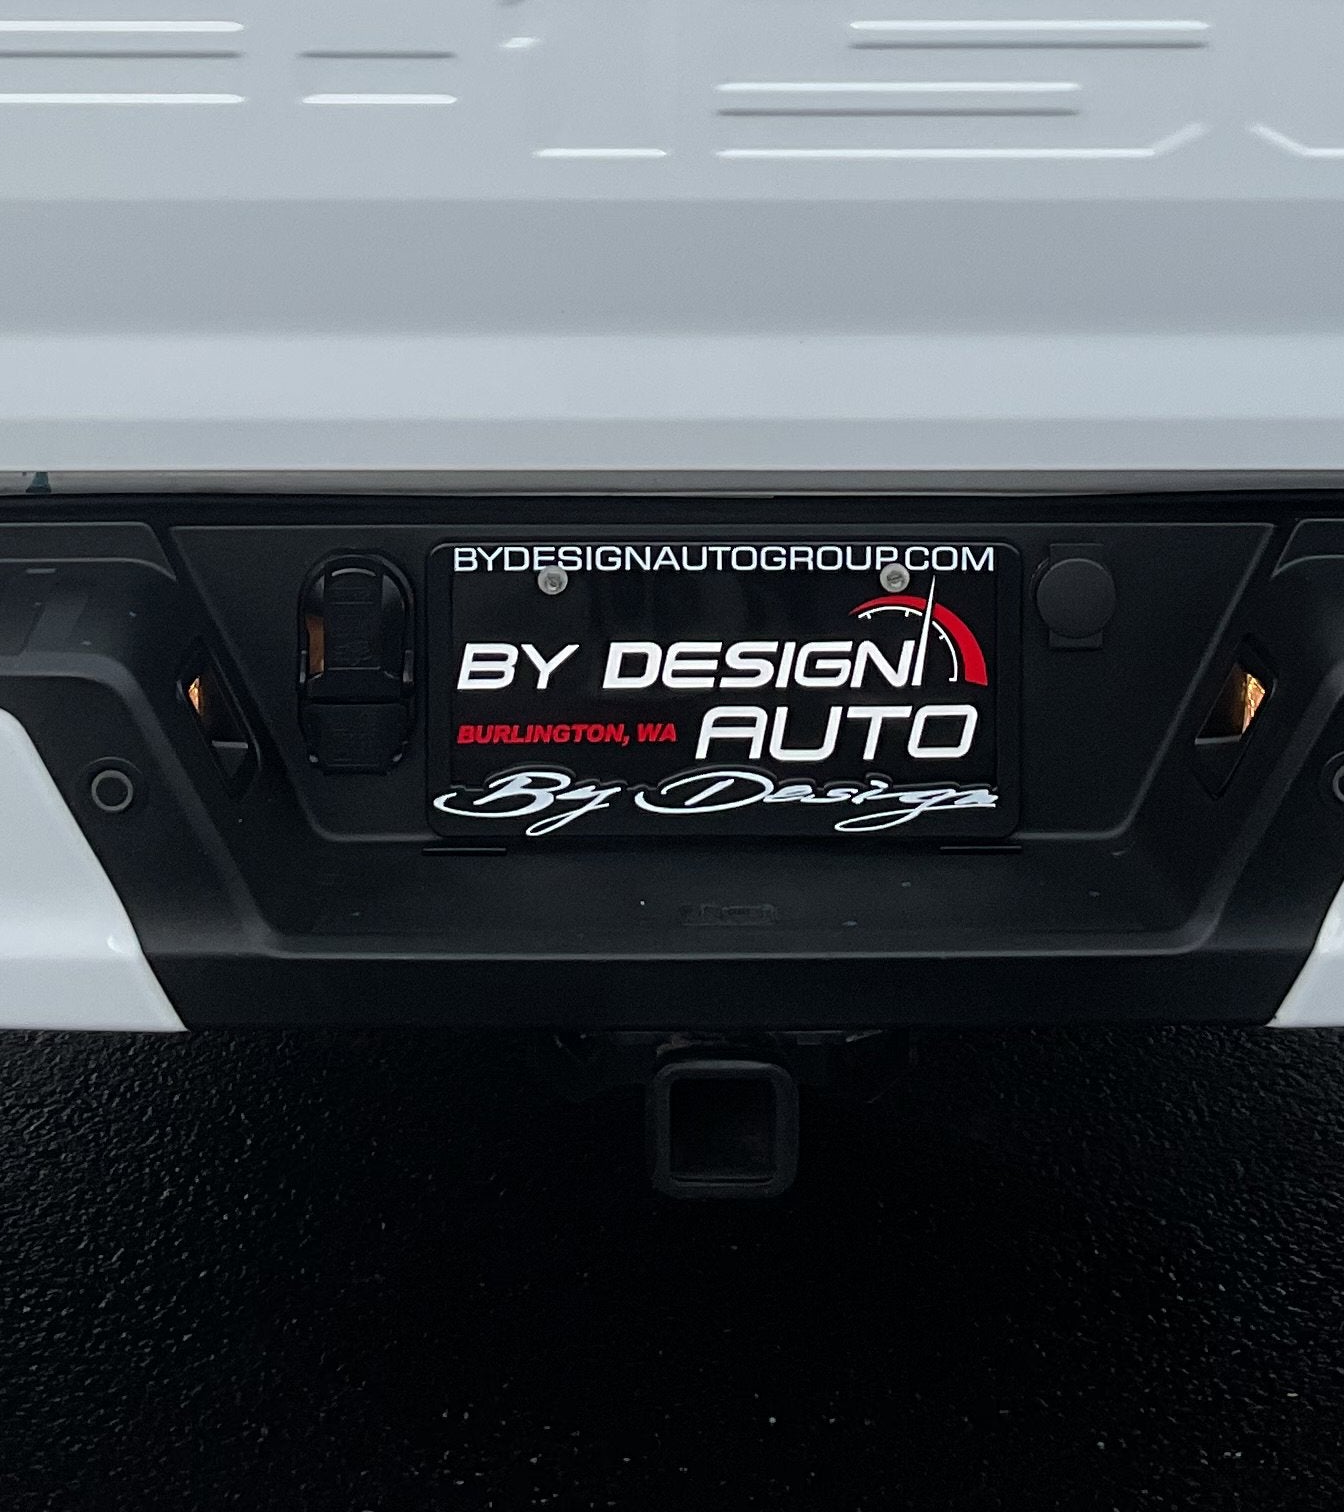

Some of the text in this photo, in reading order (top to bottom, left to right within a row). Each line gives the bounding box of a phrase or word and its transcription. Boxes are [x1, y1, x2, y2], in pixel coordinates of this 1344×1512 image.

[454, 546, 994, 571] BYDESIGNAUTOGROUPCOM
[457, 640, 915, 690] BY DESIGN
[457, 723, 677, 746] BURLINGTON, WA
[695, 705, 979, 761] AUTO
[433, 771, 998, 836] By Design
